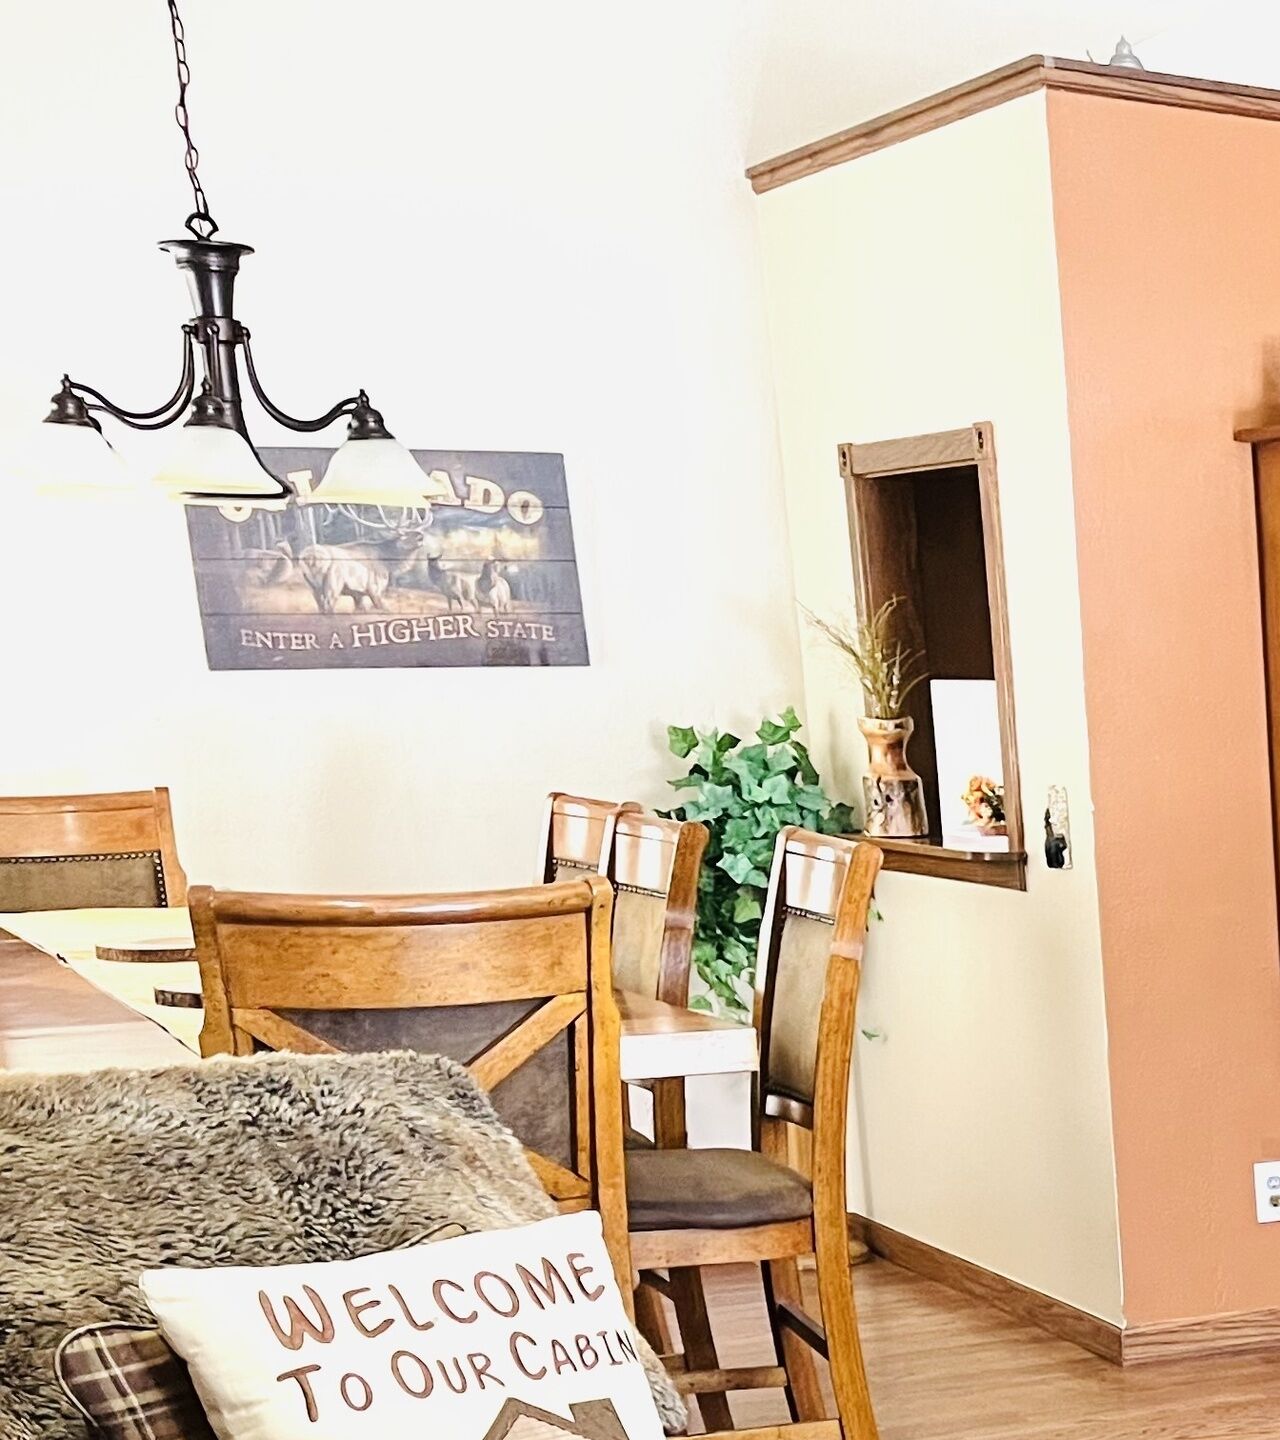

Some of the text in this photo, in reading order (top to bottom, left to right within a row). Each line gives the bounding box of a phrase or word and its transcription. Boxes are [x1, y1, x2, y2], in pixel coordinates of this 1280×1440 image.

[240, 615, 556, 650] ENTER A HIGHER STATE
[258, 1252, 606, 1351] WELCOME
[391, 1350, 506, 1400] OUR
[510, 1331, 638, 1381] CABIN
